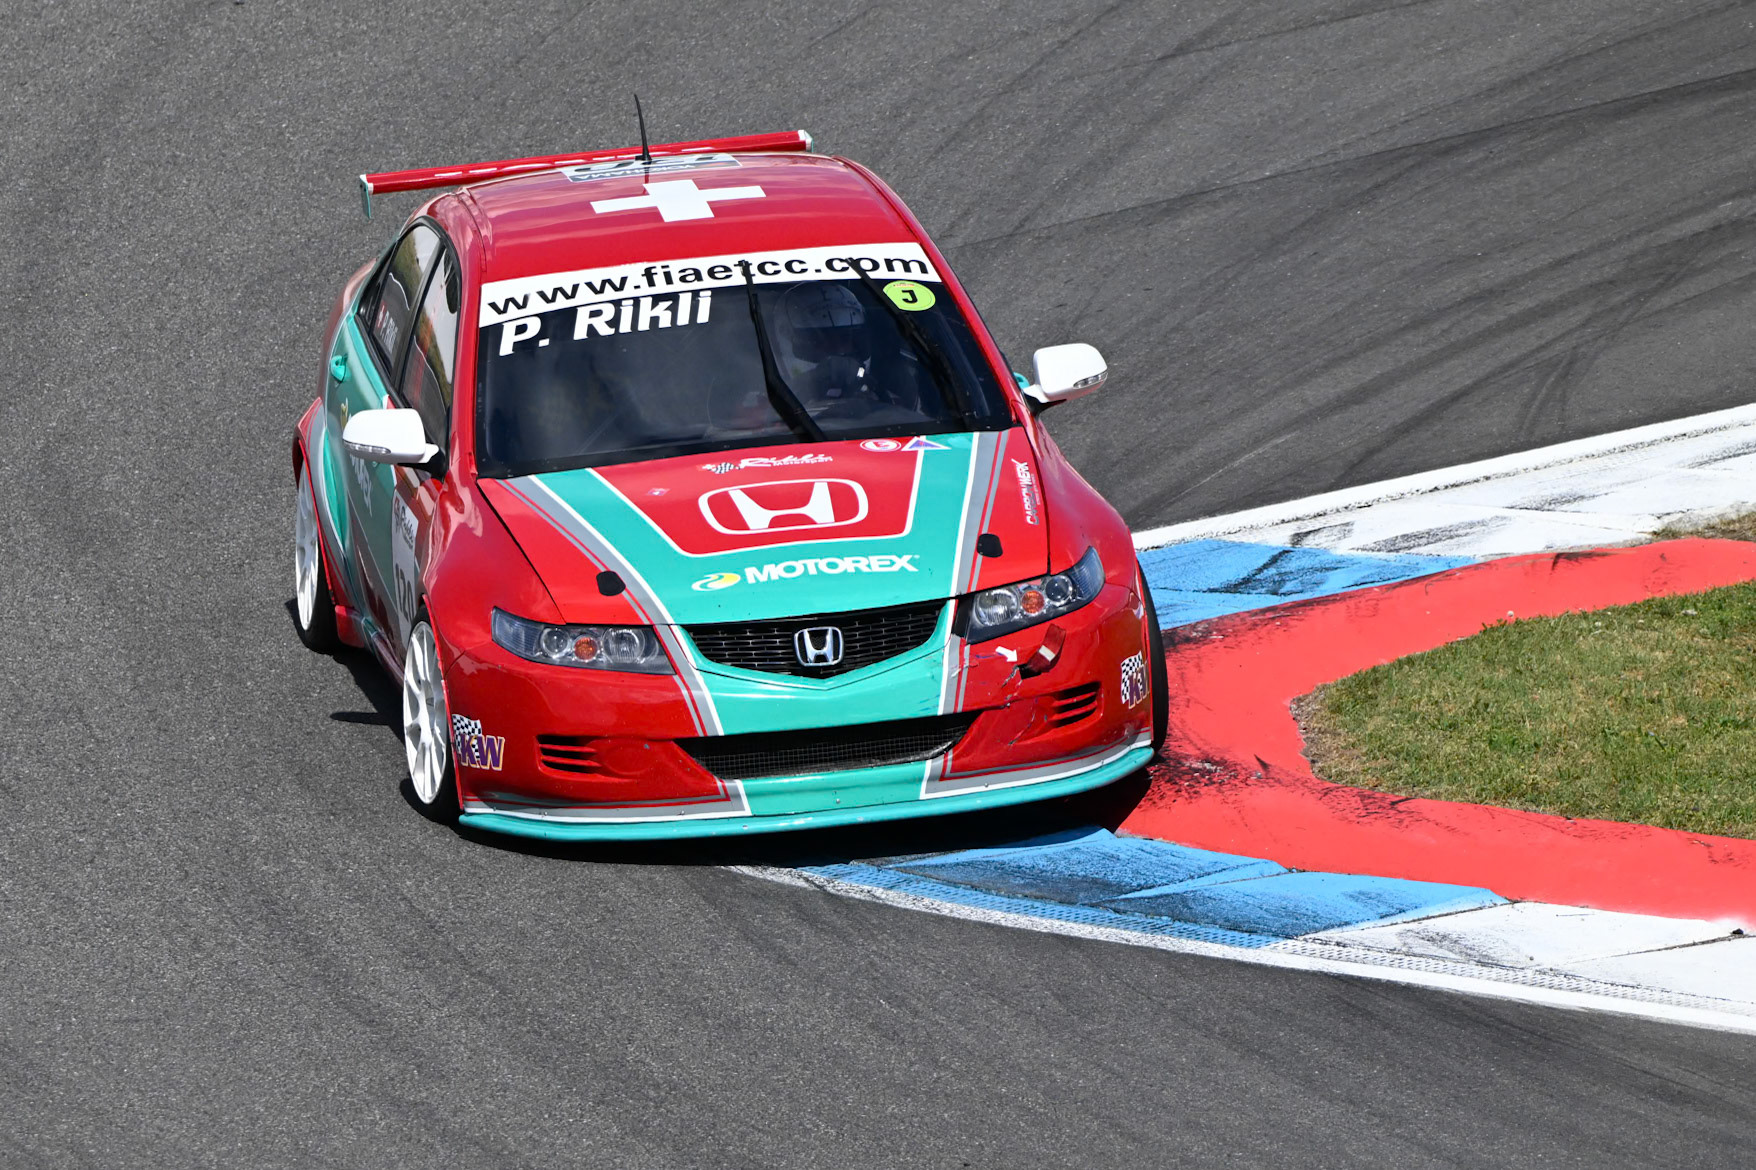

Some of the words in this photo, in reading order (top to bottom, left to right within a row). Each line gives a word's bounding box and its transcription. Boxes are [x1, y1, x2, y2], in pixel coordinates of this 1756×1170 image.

[902, 290, 918, 304] J
[498, 318, 551, 356] P.
[573, 290, 713, 341] Rikli
[744, 555, 917, 583] MOTOREX
[460, 734, 504, 770] KW
